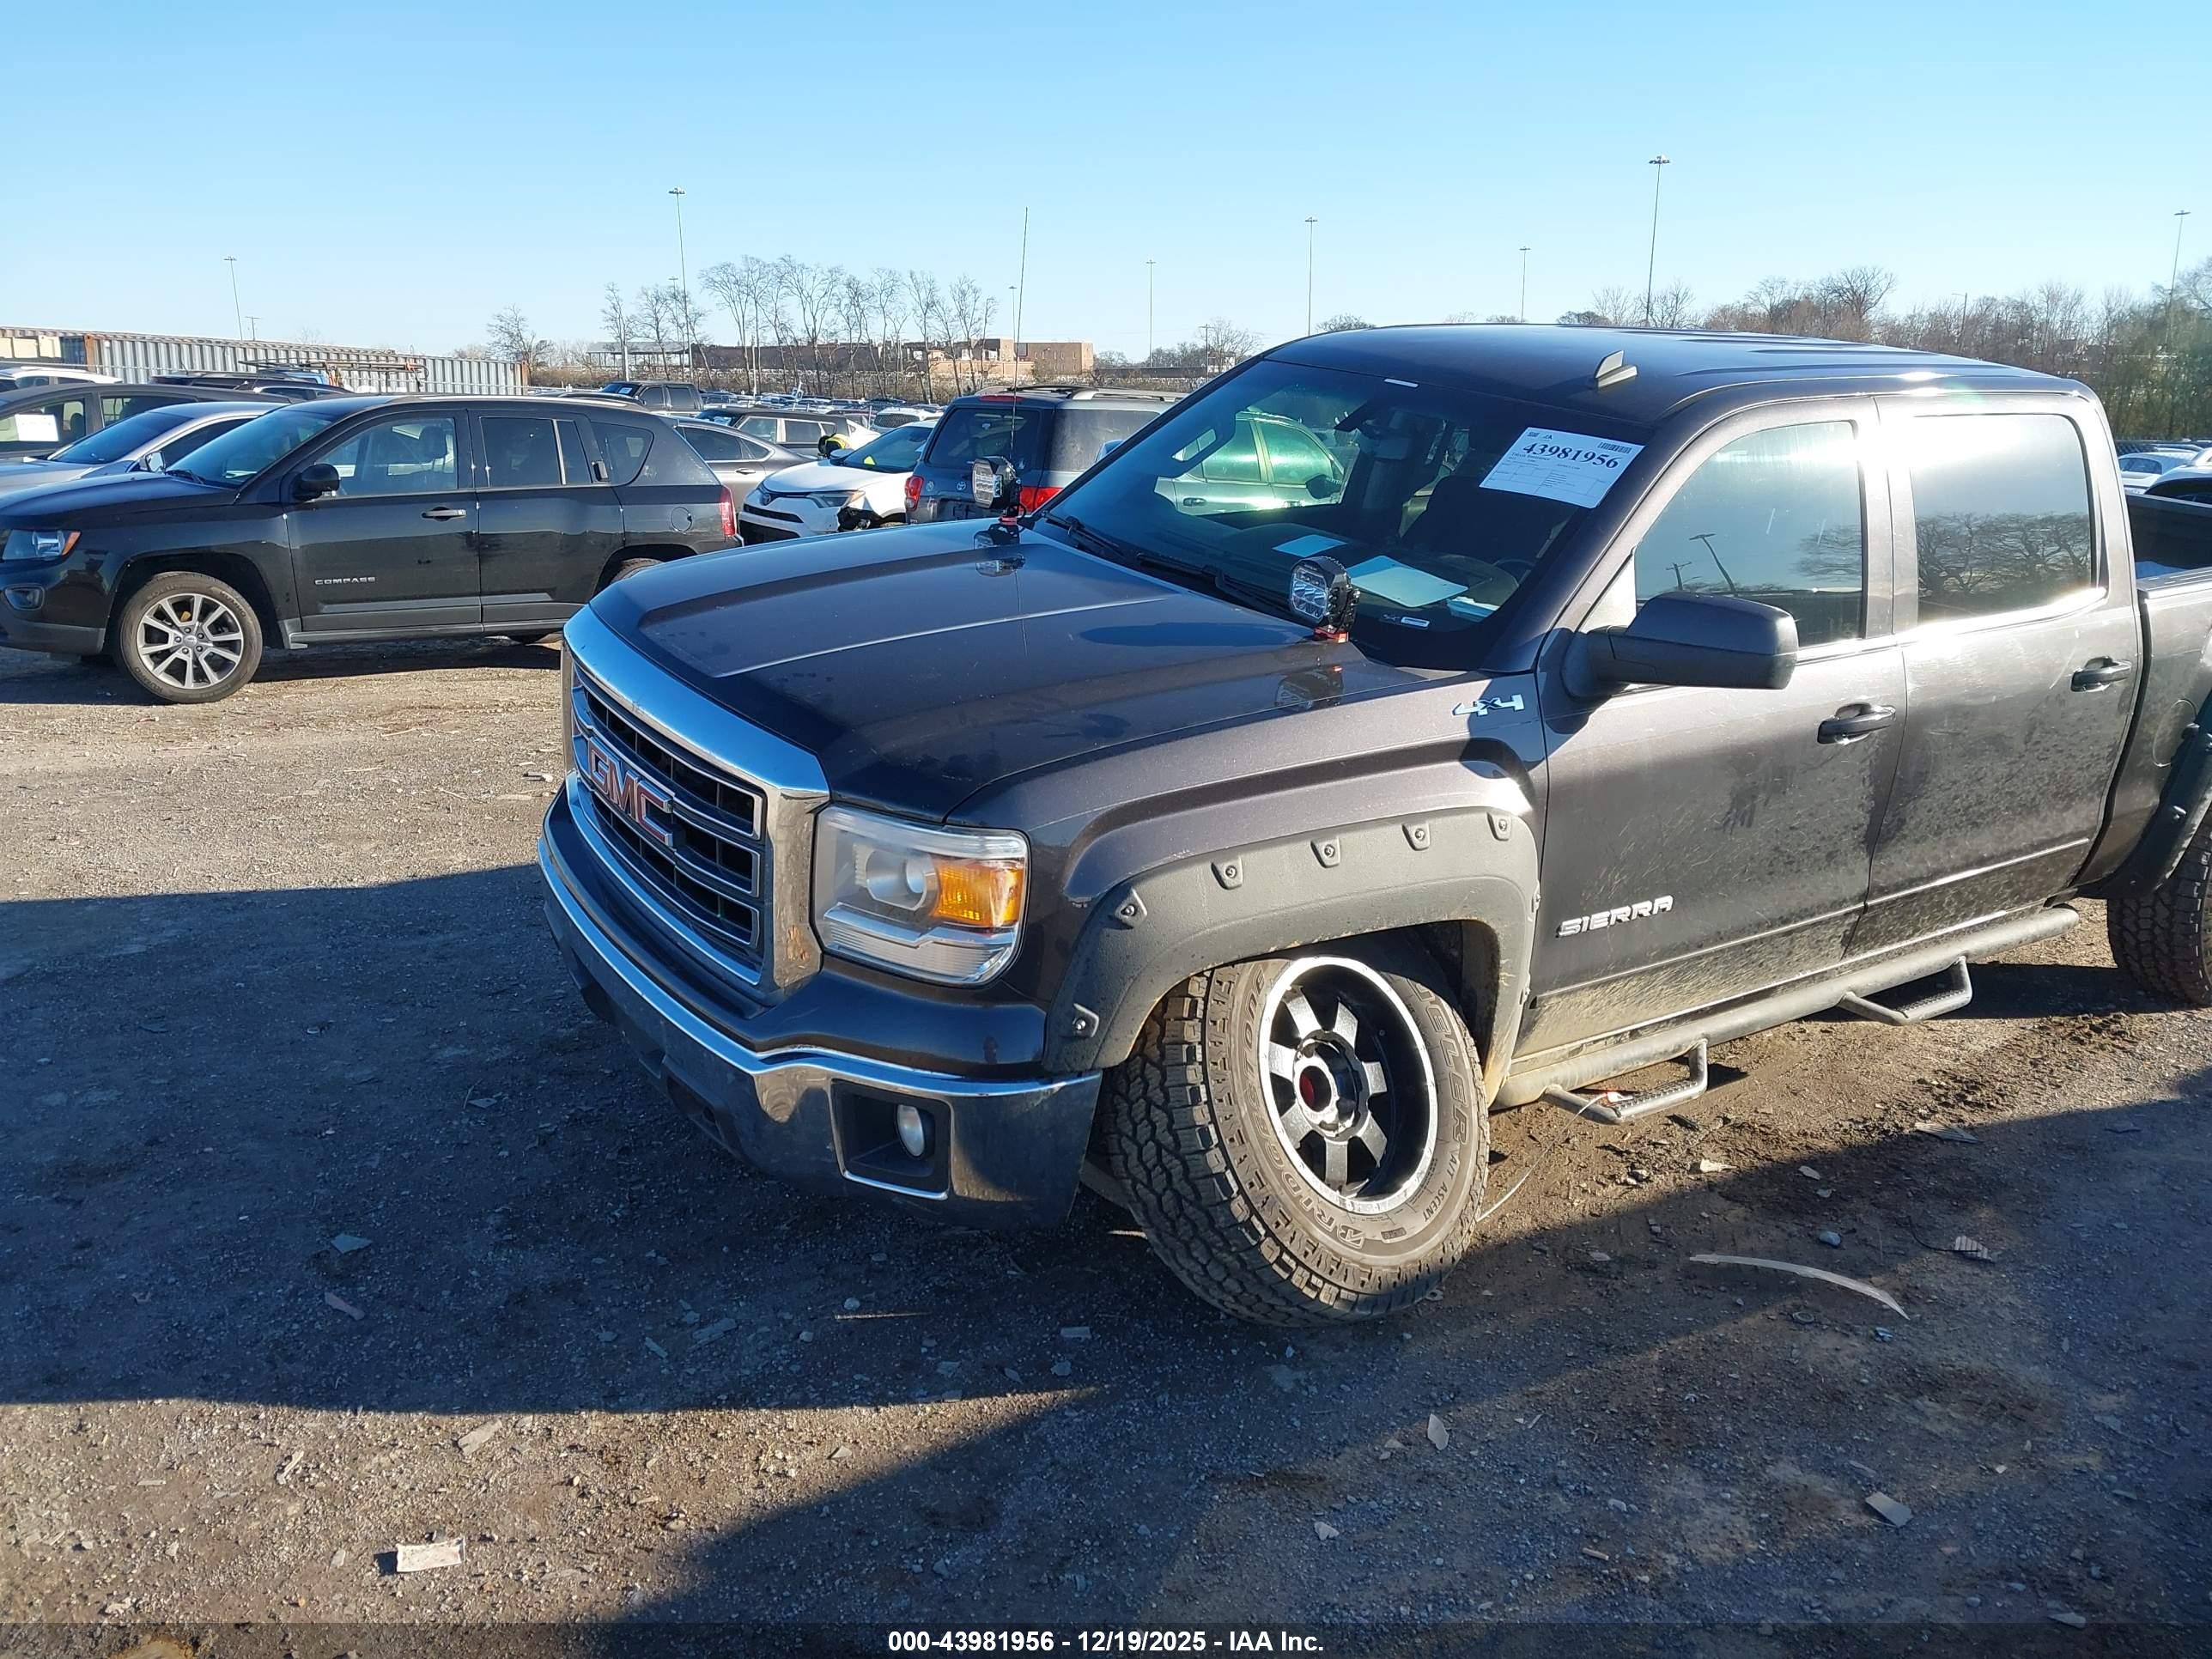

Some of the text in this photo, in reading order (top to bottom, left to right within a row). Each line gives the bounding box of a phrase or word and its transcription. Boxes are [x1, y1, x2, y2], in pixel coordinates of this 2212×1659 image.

[1522, 441, 1622, 469] 43981956
[314, 576, 375, 585] COMPASS
[588, 736, 673, 848] GMC
[1558, 895, 1674, 937] SIERRA
[1244, 964, 1366, 1249] BRIDGESTONE
[1422, 1183, 1449, 1223] ASCENT
